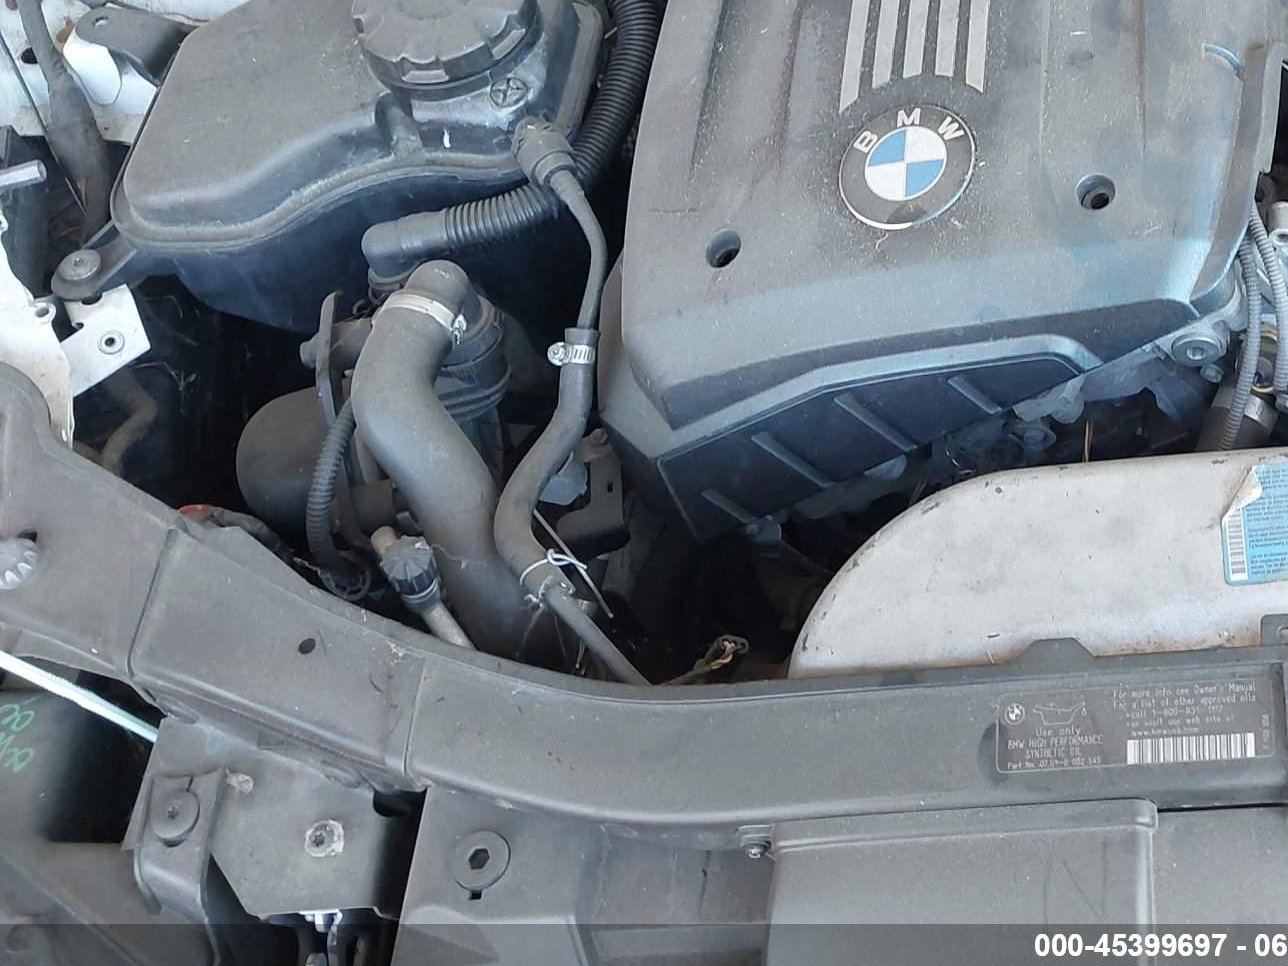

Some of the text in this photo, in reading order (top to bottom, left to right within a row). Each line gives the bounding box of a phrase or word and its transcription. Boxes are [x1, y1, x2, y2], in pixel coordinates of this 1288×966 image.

[852, 107, 965, 154] BMW
[1228, 682, 1256, 692] Manual
[1036, 725, 1081, 737] Use only
[1008, 739, 1026, 750] BMW
[1050, 734, 1103, 748] PERFORMANCE
[1025, 747, 1067, 759] SYNTHETIC
